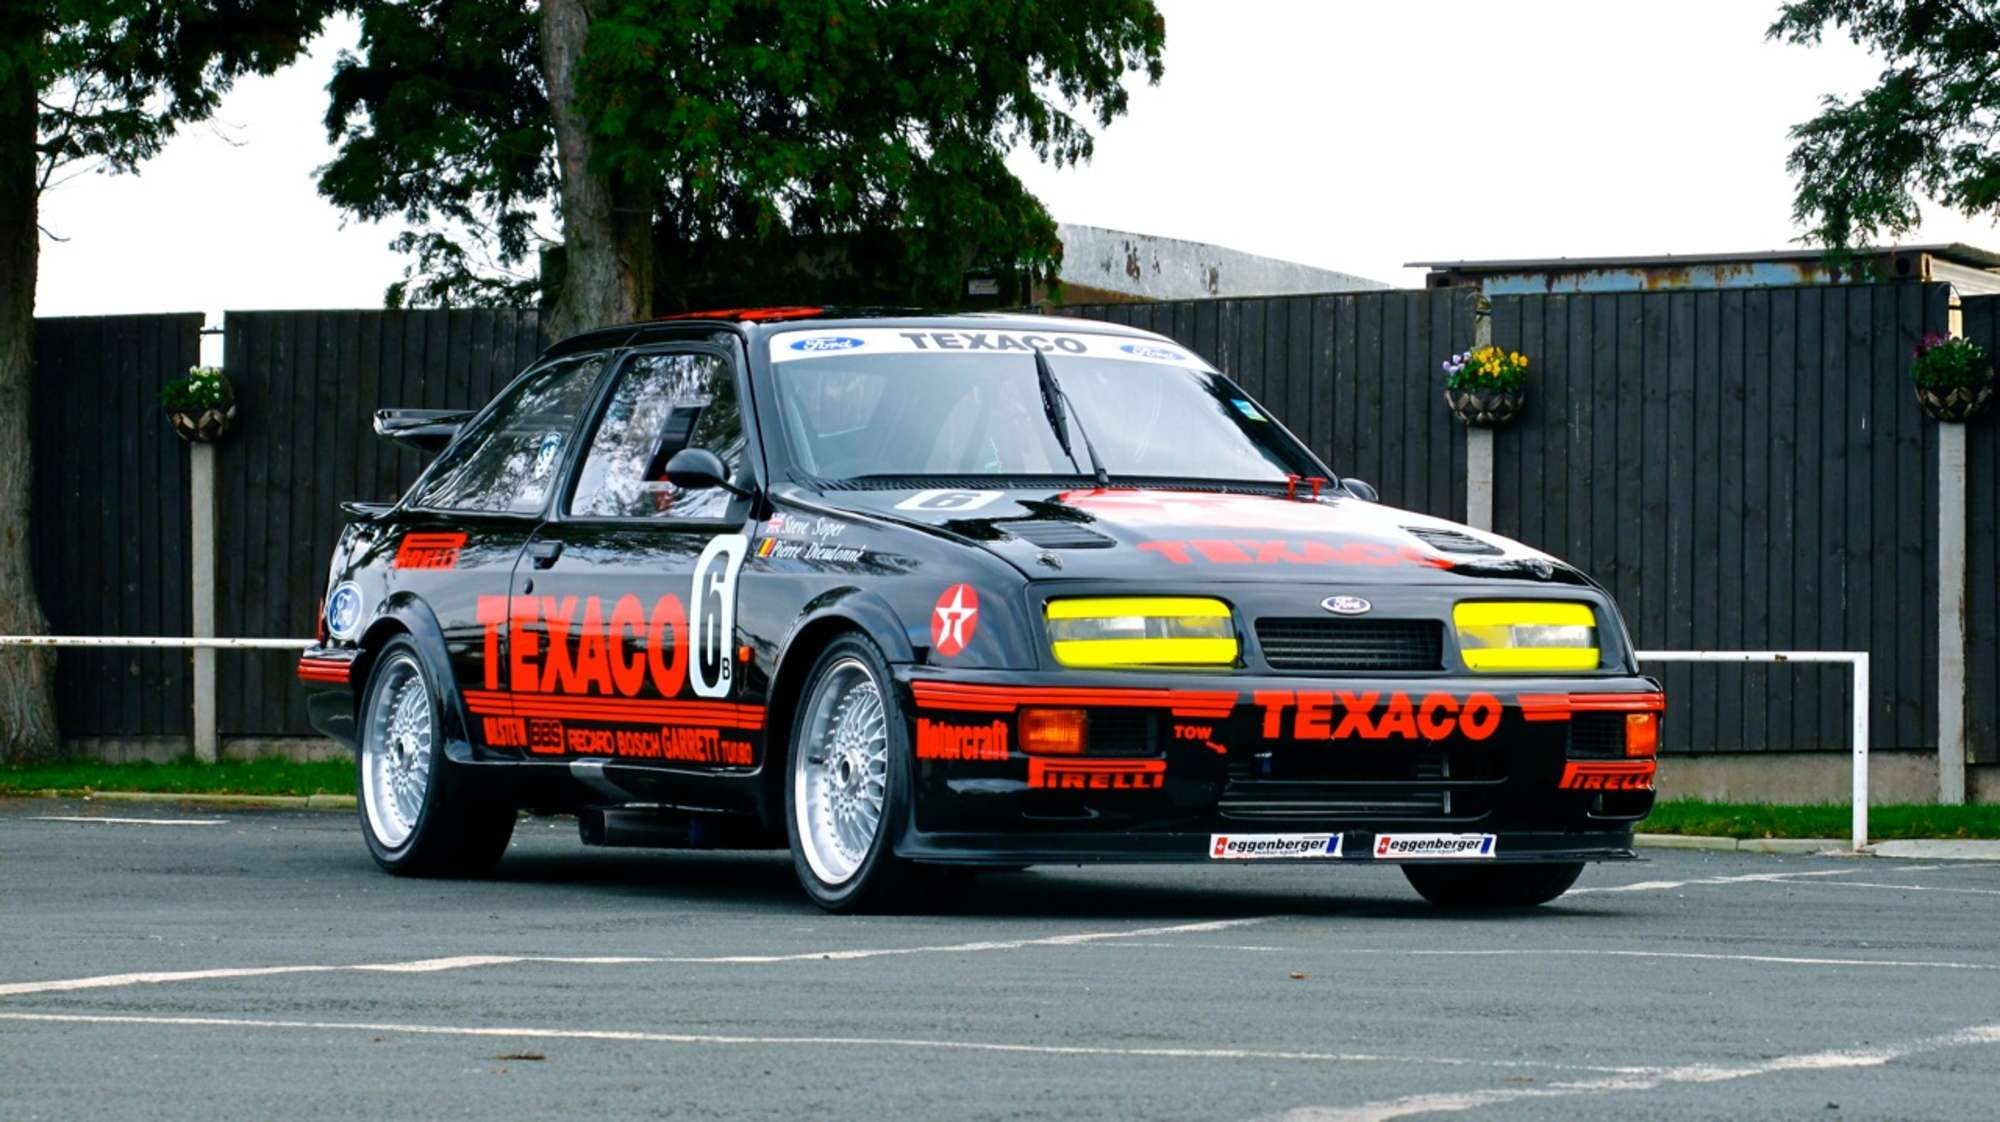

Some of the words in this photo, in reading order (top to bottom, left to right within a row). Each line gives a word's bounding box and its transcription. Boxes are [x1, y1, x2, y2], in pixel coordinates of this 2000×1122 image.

[803, 337, 853, 351] Ford
[899, 332, 1087, 353] TEXACO
[918, 493, 982, 508] 6
[781, 516, 810, 535] Steve
[812, 517, 847, 541] Soper
[770, 540, 802, 559] Pierre
[1334, 597, 1361, 609] Ford
[699, 550, 730, 689] 6
[475, 593, 689, 698] TEXACO
[721, 657, 731, 680] B
[1253, 690, 1503, 741] TEXACO
[530, 719, 564, 753] BBS
[567, 729, 615, 754] RECARO
[616, 731, 661, 757] BOSCH
[661, 726, 720, 762] GARRETT
[917, 718, 1009, 760] Motorcraft
[1173, 725, 1212, 739] TOW
[1028, 758, 1167, 788] PIRELLI
[1227, 838, 1327, 853] eggenberger
[1390, 838, 1481, 852] eggenberger
